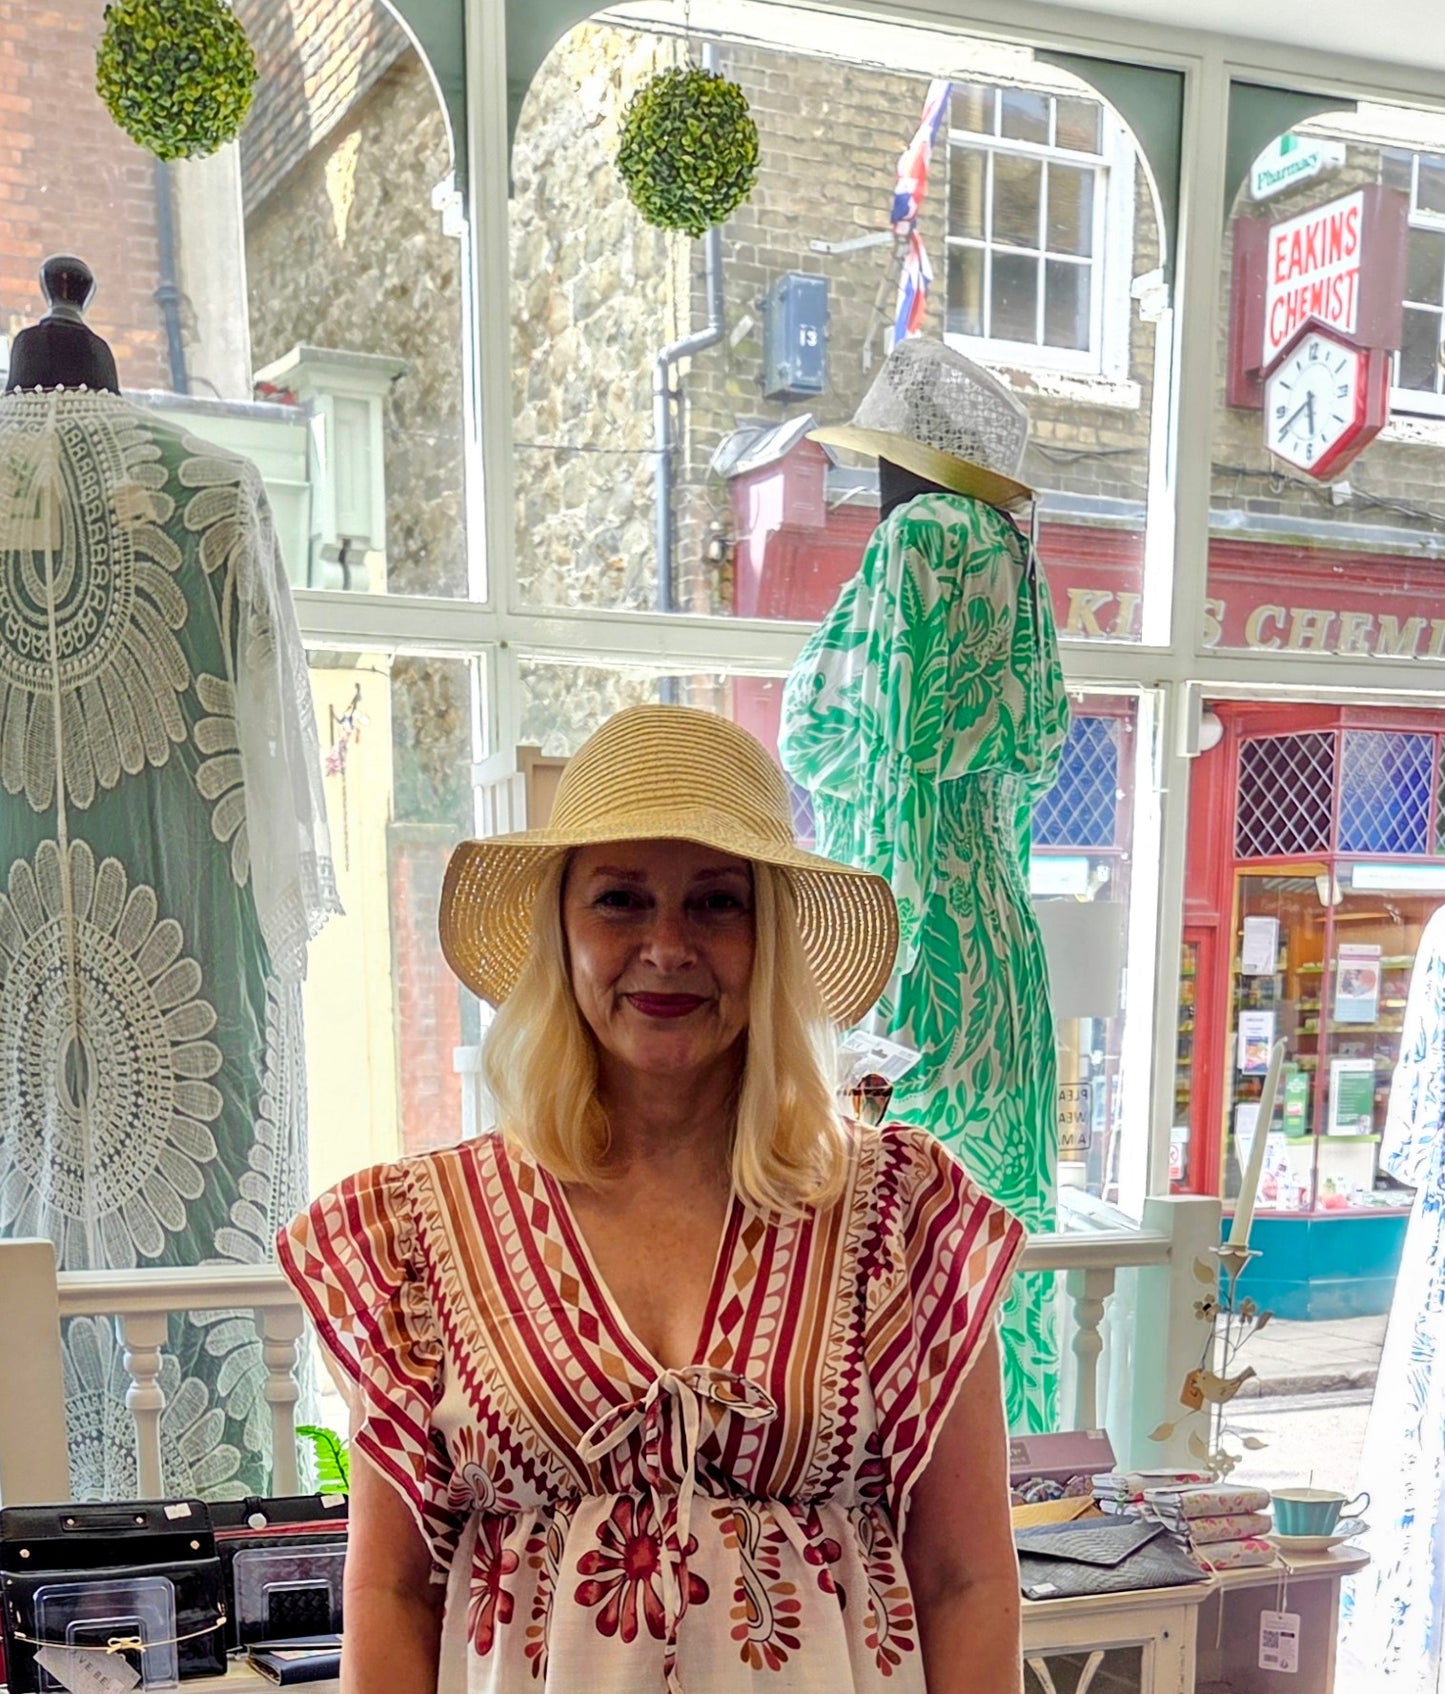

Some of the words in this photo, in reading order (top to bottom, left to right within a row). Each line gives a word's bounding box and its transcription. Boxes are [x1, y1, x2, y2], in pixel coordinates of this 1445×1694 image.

[1257, 153, 1318, 190] Pharmacy
[1274, 206, 1358, 285] EAKINS
[1269, 268, 1359, 348] CHEMIST
